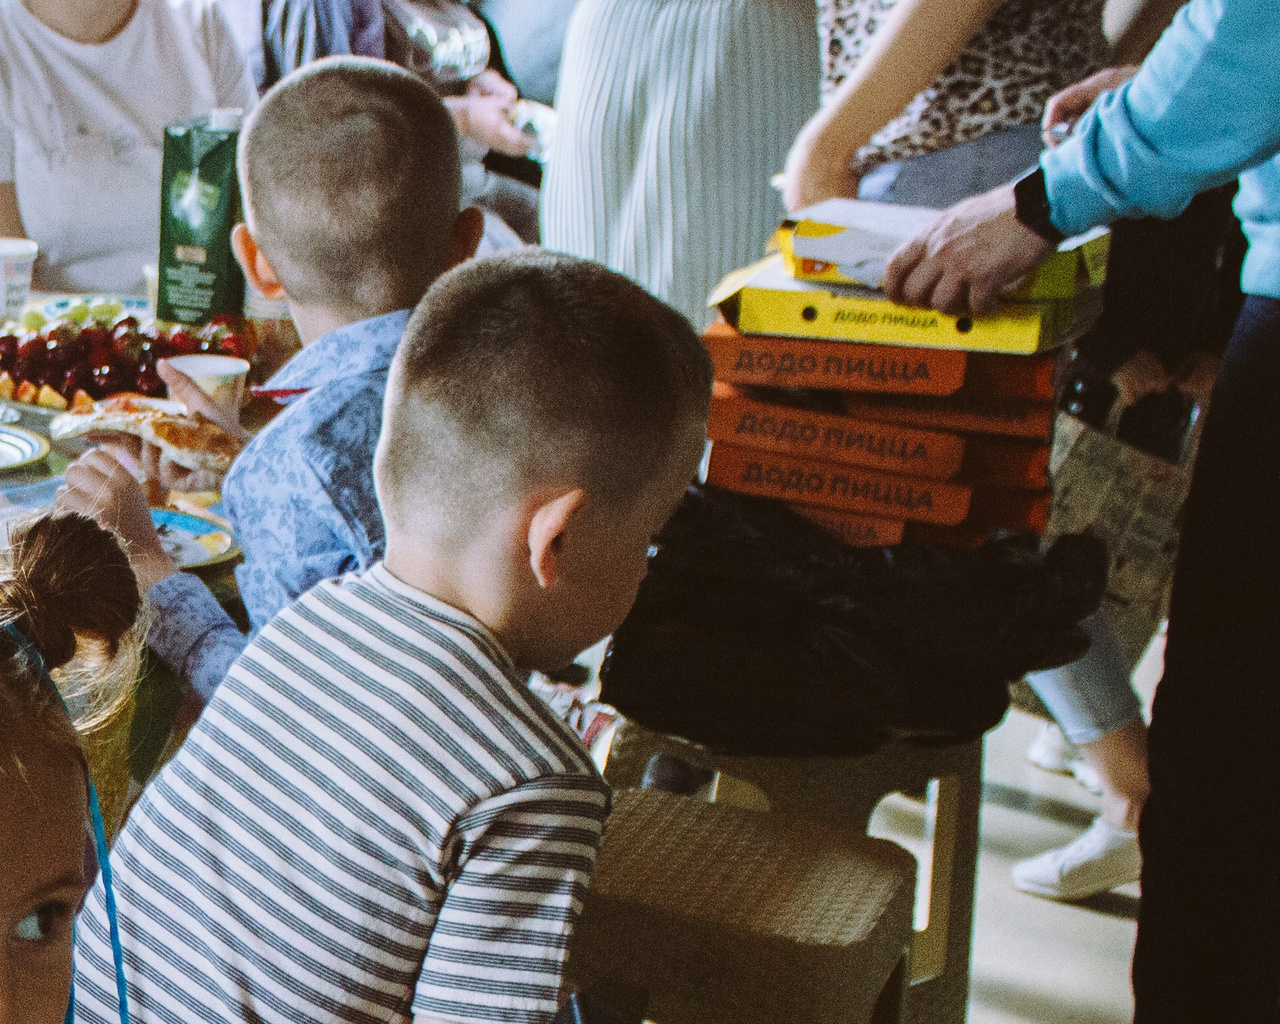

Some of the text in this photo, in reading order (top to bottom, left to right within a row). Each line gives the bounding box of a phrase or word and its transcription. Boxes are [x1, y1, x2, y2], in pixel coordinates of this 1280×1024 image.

[833, 309, 939, 329] ДОДО ПИЦЦА
[734, 349, 930, 384] ДОДО ПИЦЦА
[734, 413, 928, 462] ДОДО ПИЦЦА
[740, 461, 933, 510] ДОДО ПИЦЦА
